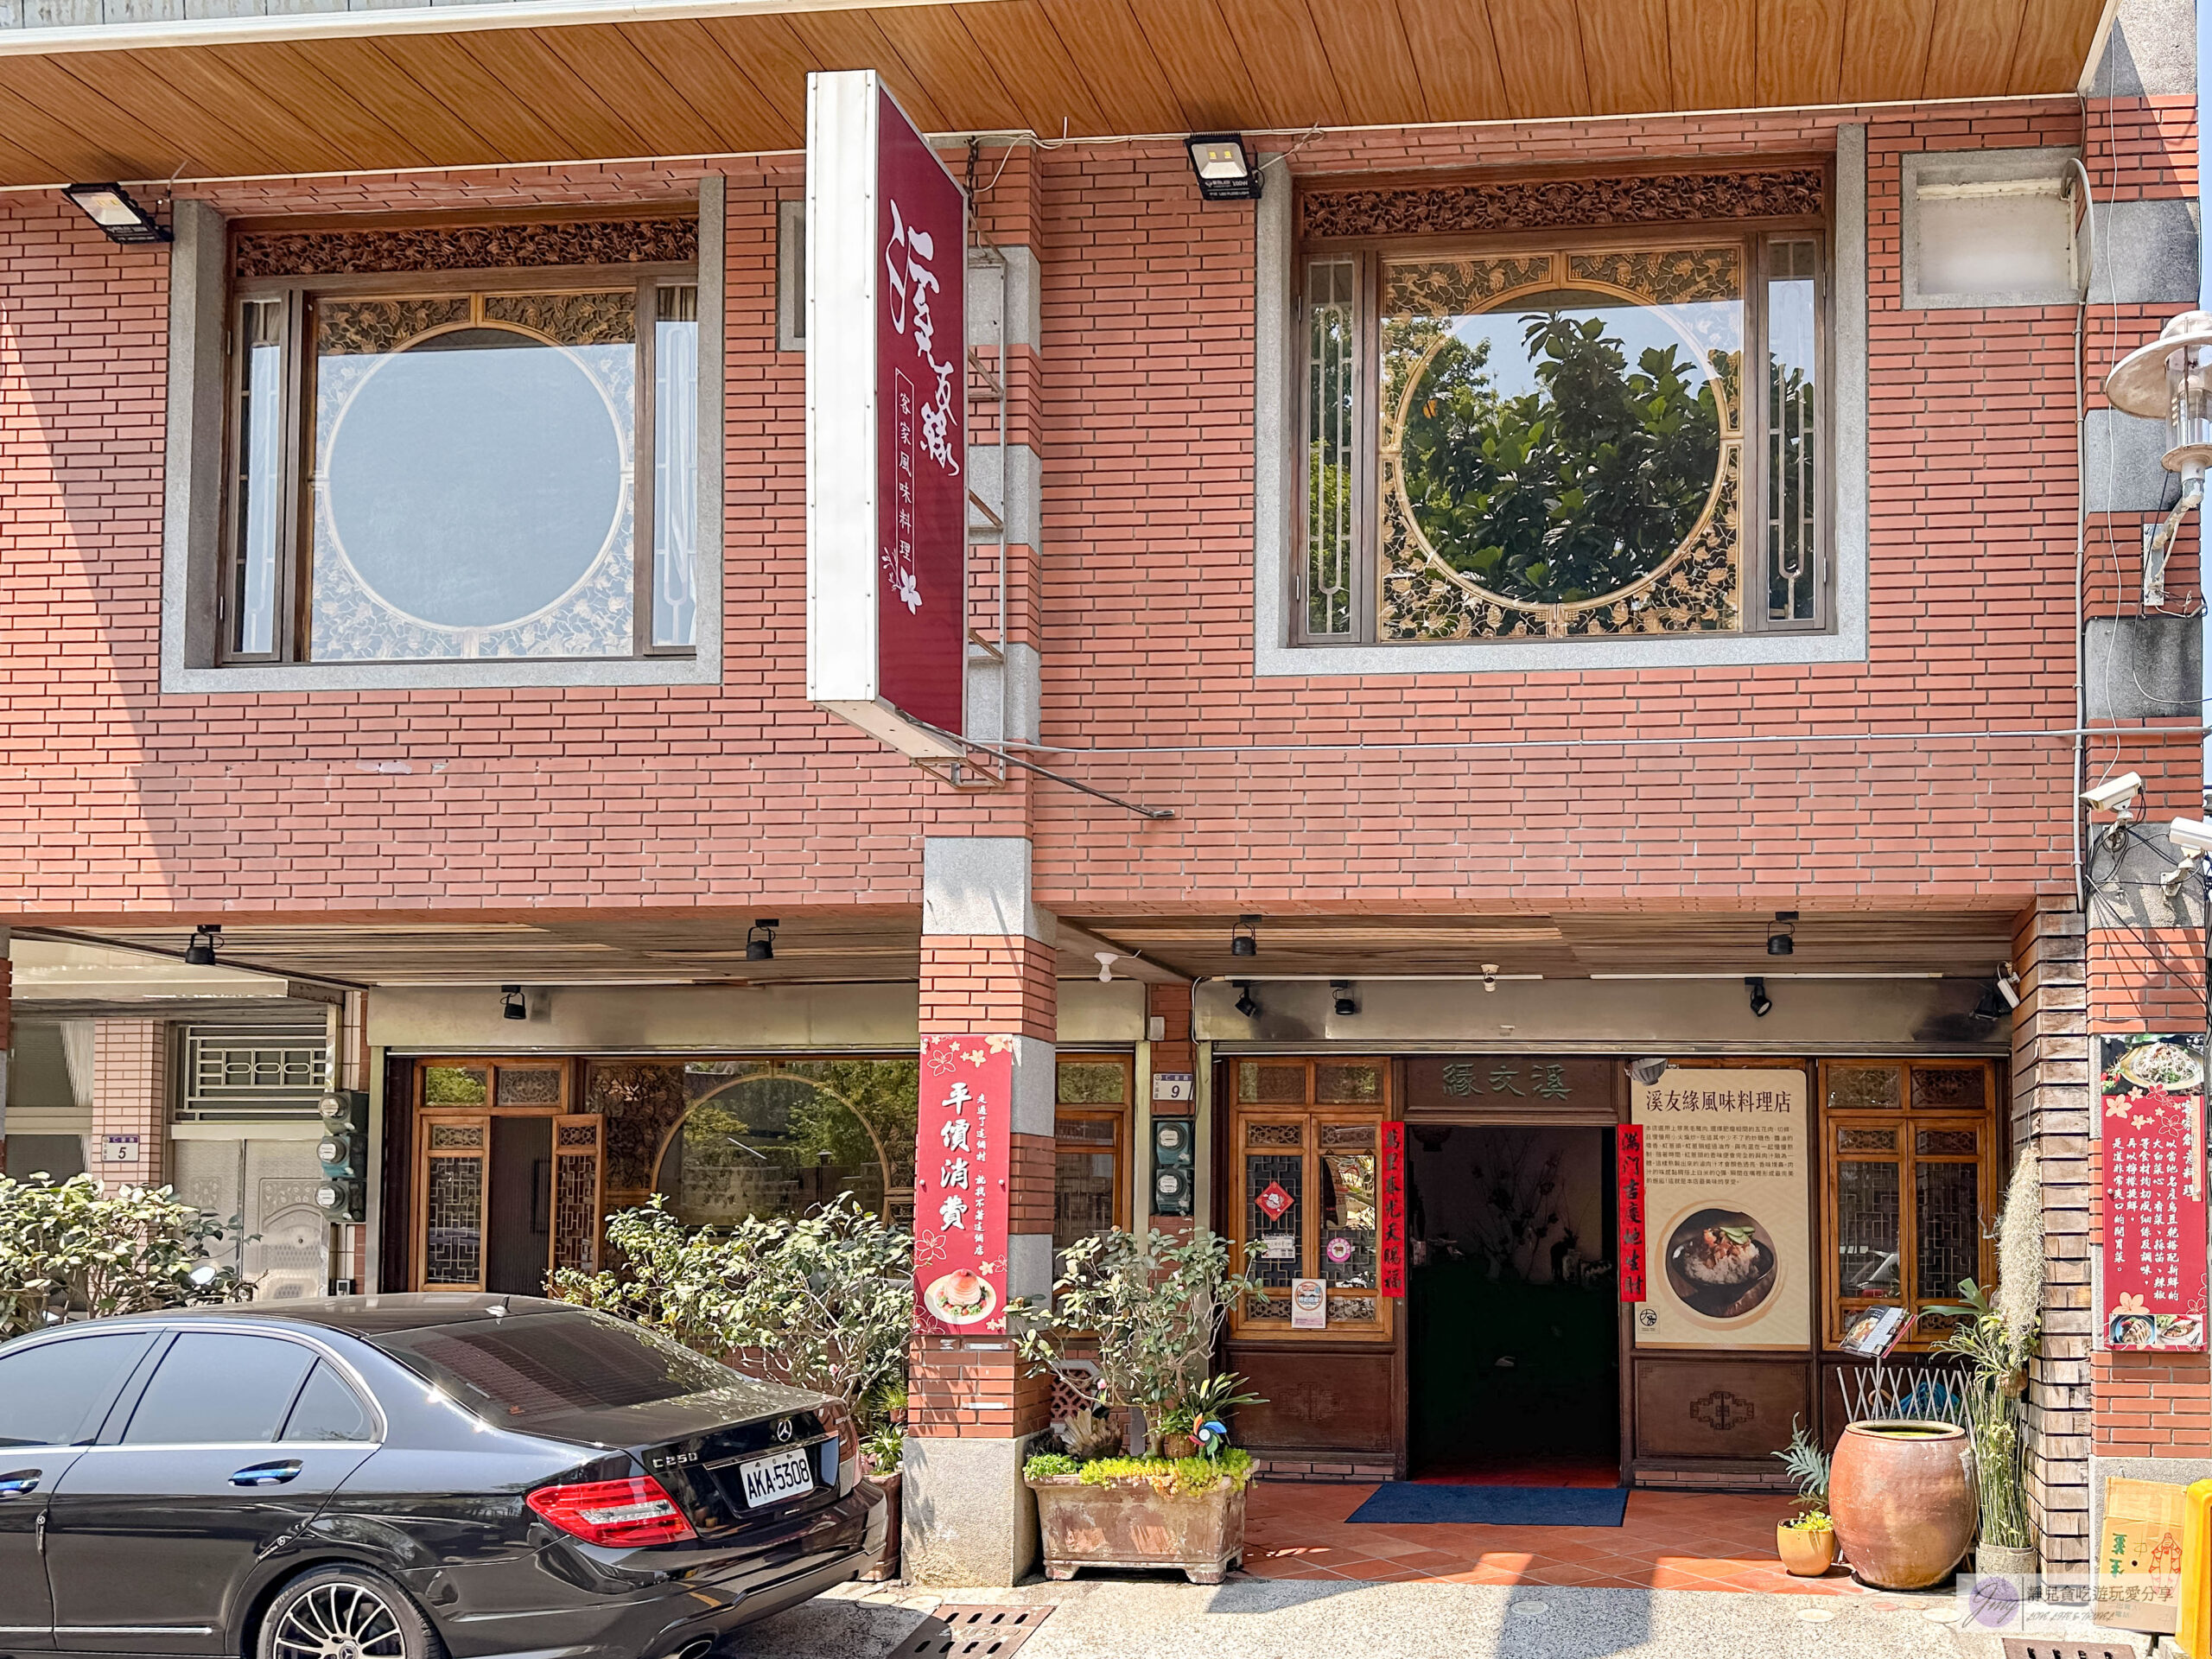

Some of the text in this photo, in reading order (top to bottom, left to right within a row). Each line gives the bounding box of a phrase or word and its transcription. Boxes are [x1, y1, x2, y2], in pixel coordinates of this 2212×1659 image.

[899, 392, 912, 563] 客家風味料理
[1171, 1085, 1180, 1098] 9
[1645, 1090, 1791, 1113] 溪友緣風味料理店
[118, 1147, 127, 1160] 5
[939, 1082, 973, 1232] 平價消費
[2181, 1099, 2197, 1197] 客家創意料理
[652, 1452, 698, 1469] C250
[747, 1458, 810, 1500] AKA-5308
